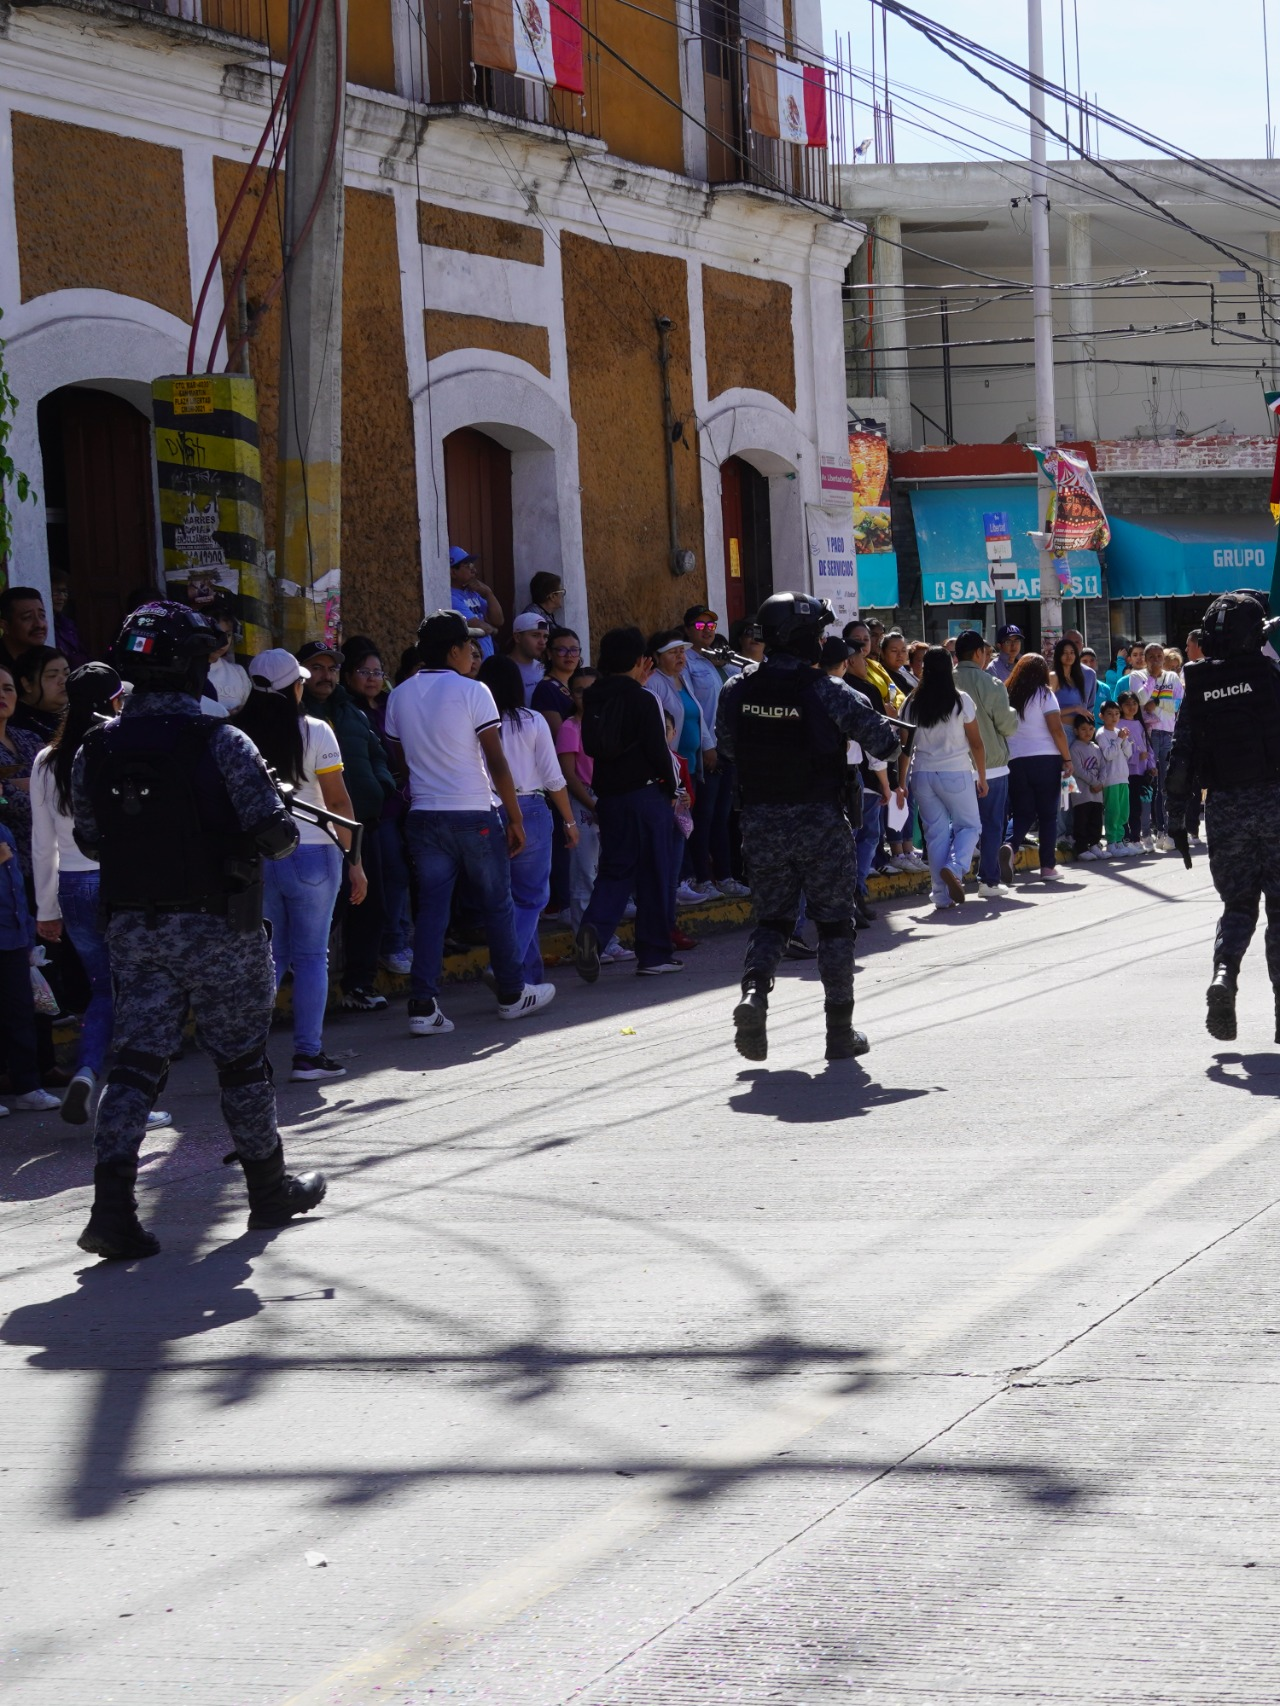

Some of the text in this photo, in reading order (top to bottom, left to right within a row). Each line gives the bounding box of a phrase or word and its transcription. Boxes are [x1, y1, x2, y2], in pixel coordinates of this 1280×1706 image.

[826, 537, 845, 553] Y PAGO
[1213, 549, 1265, 567] GRUPO
[819, 560, 854, 576] DE SERVICIOS
[1203, 682, 1253, 702] POLICÍA
[742, 704, 800, 717] POLICIA
